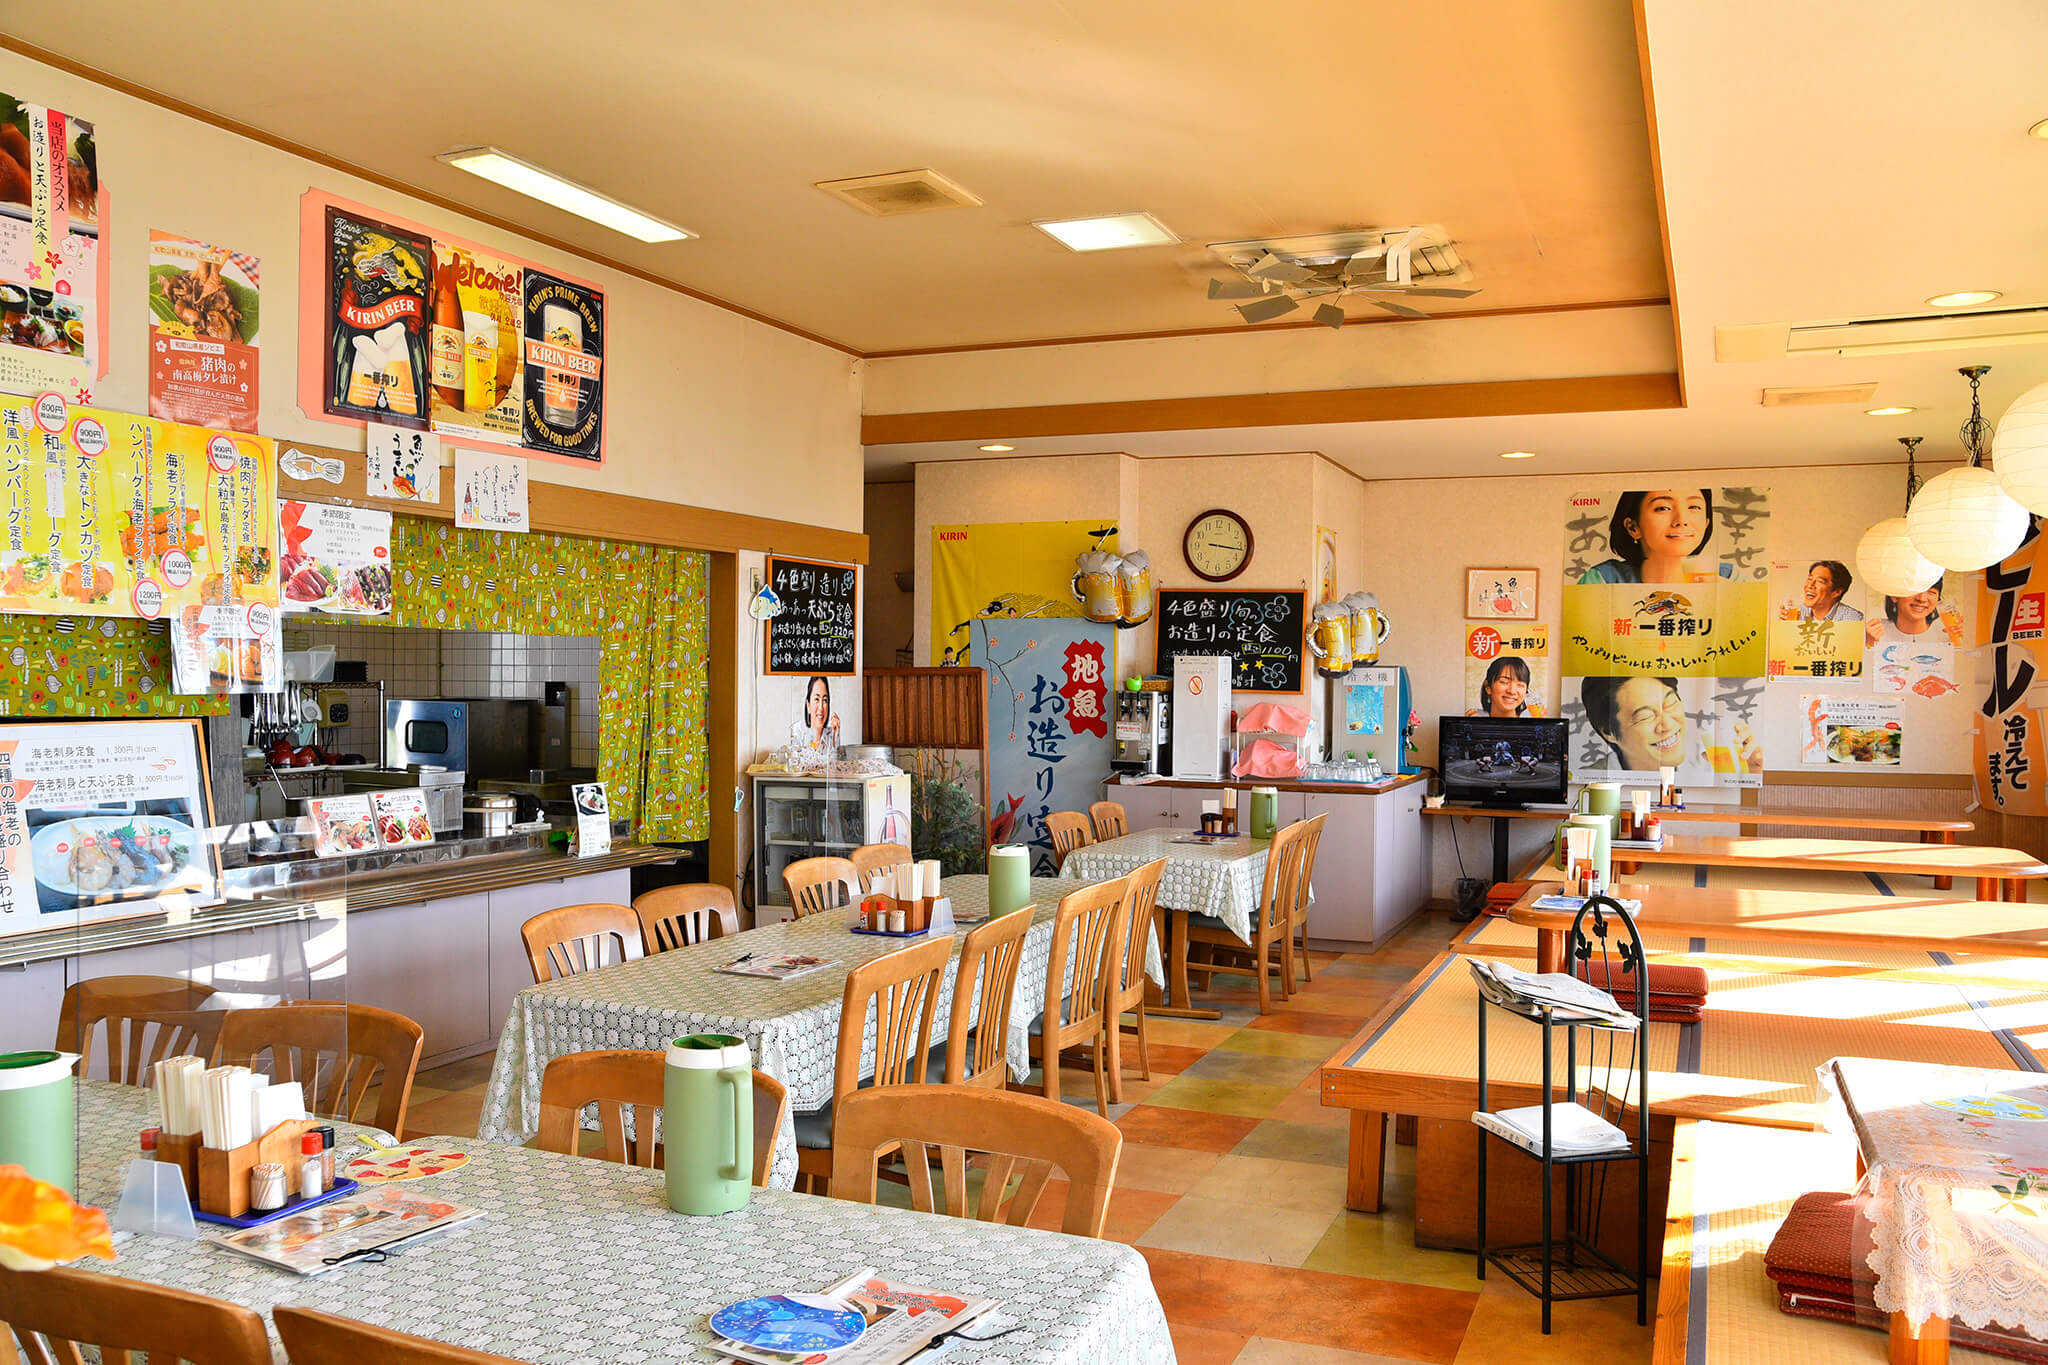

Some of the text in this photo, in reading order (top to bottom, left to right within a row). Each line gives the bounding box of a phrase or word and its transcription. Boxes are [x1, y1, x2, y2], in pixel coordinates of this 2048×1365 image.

[51, 121, 65, 212] 当店のオススメ
[32, 116, 48, 245] お造りと天ぷら定食
[432, 252, 522, 296] Welcome!
[346, 299, 415, 325] KIRIN BEER
[528, 286, 554, 314] KIRIN'S
[554, 285, 580, 307] PRIME
[579, 301, 599, 333] BREW
[531, 344, 597, 375] KIRIN BEER
[41, 403, 63, 414] 800円
[80, 428, 102, 439] 900円
[526, 399, 550, 438] BREWED
[549, 430, 563, 447] FOR
[563, 433, 583, 447] GOOD
[580, 411, 598, 439] TIMES
[214, 444, 233, 455] 900円
[3, 408, 22, 551] 洋風ハンバーグ定食
[43, 434, 62, 574] 和風ーグ定食
[165, 453, 179, 545] 海老フライ定食
[240, 455, 251, 542] 焼肉サラダ定食
[1573, 498, 1601, 506] KIRIN
[76, 455, 93, 588] 大きなトンカツ定食
[218, 475, 232, 606] 大粒広島産カキフライ定食
[939, 532, 968, 541] KIRIN
[168, 560, 191, 570] 1000円
[139, 591, 161, 600] 1200円
[2014, 599, 2042, 625] 生
[1168, 622, 1280, 643] お造りの定食
[1473, 631, 1546, 656] 新 一番搾り
[2013, 630, 2042, 639] BEER
[1072, 654, 1099, 719] 地魚
[31, 745, 95, 759] 海老刺身定食
[34, 773, 135, 792] 海老刺身と天ぷら定食
